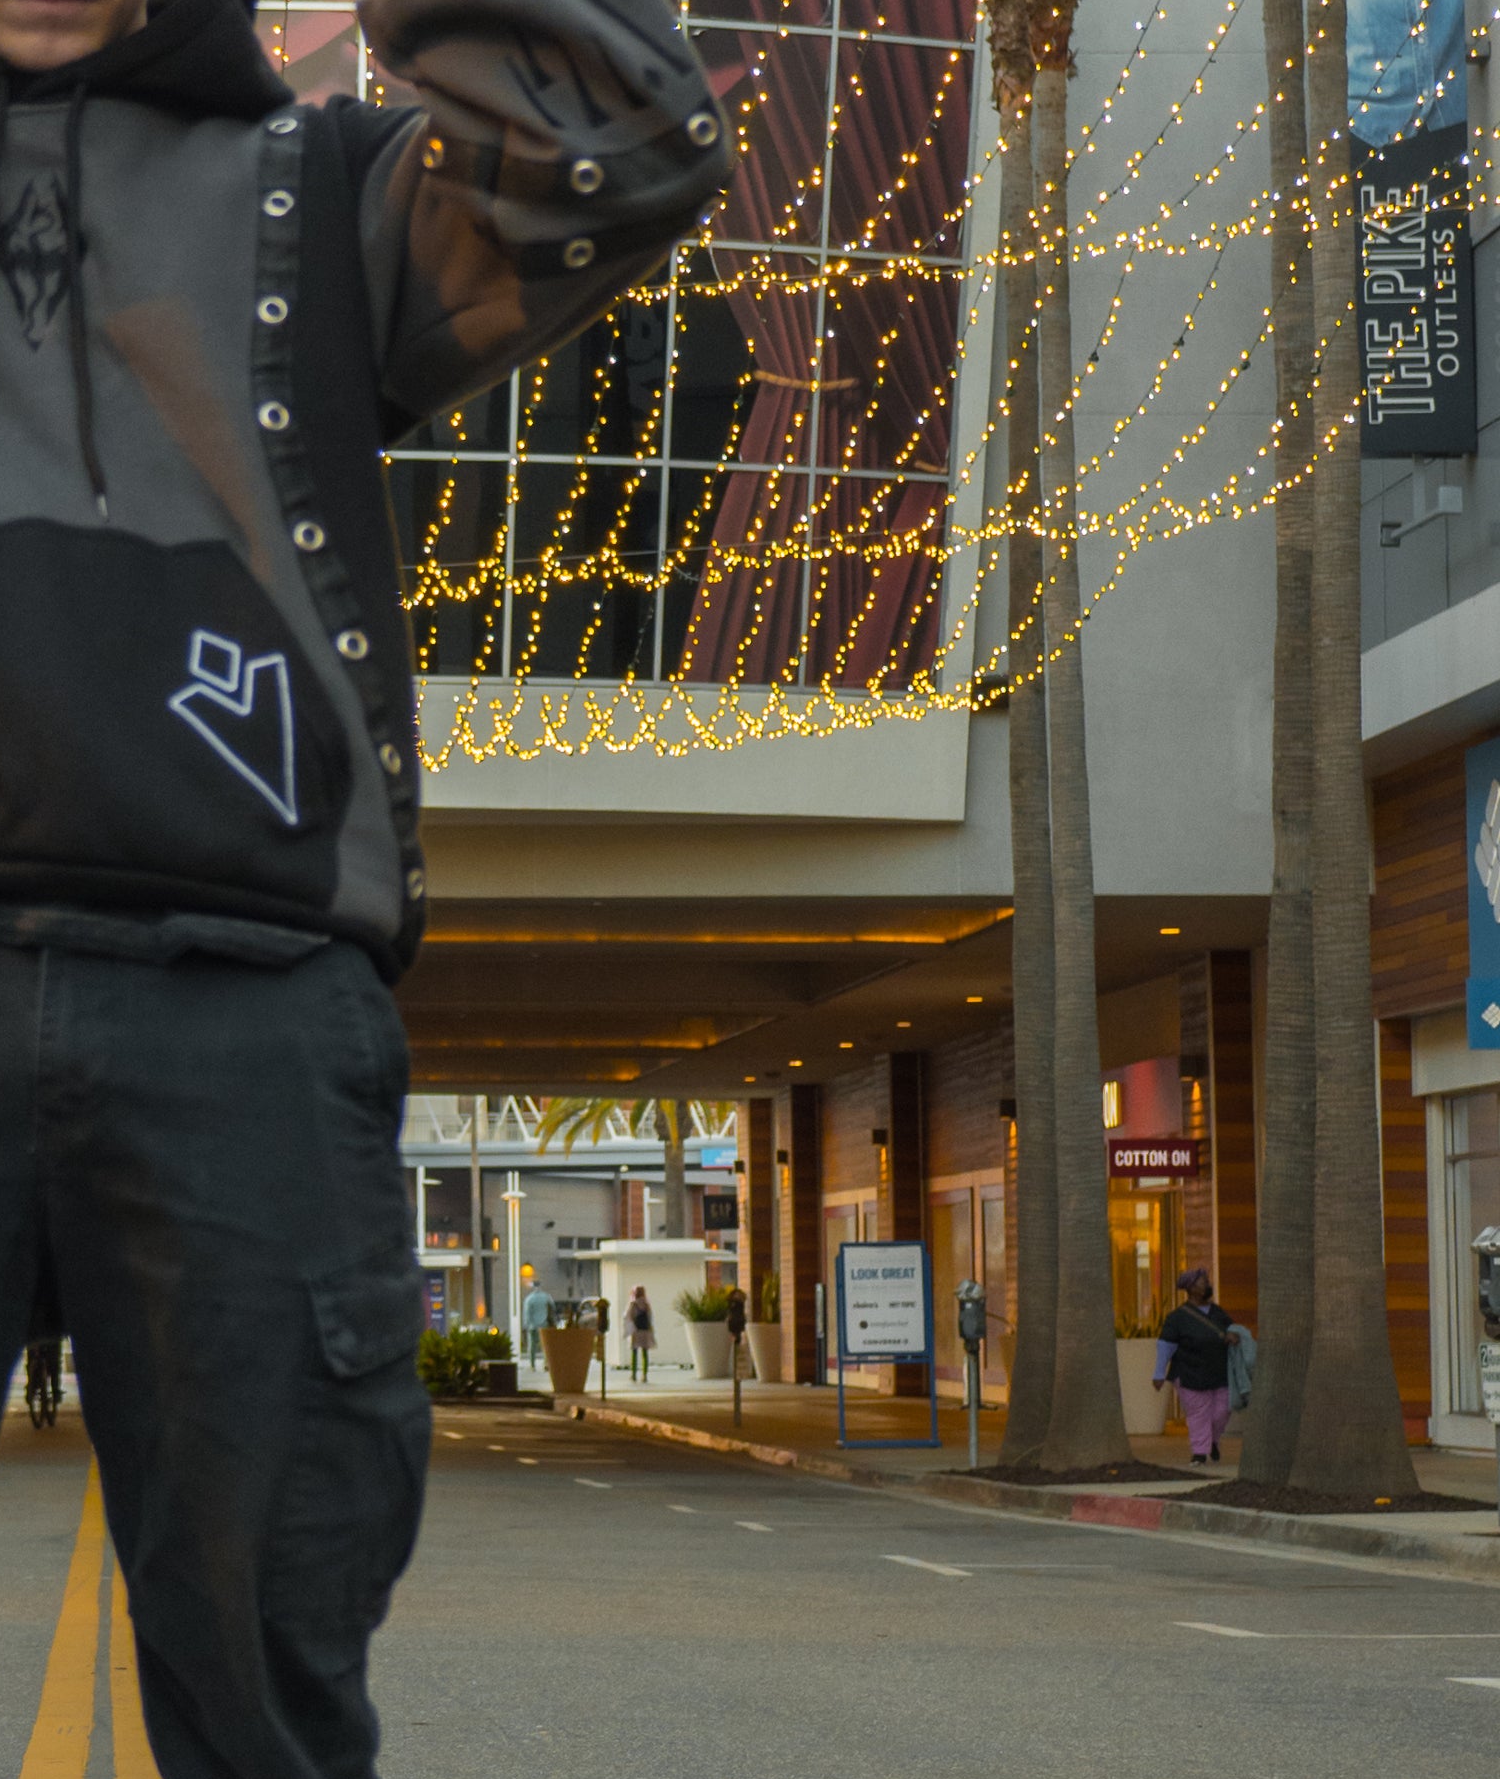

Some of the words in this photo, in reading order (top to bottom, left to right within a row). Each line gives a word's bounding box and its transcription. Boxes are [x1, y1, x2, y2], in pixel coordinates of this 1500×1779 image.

[1361, 184, 1429, 305] PIKE
[1432, 228, 1460, 377] OUTLETS
[1364, 319, 1436, 425] THE
[1114, 1150, 1168, 1167] COTTON
[1171, 1150, 1191, 1167] ON
[851, 1268, 879, 1280] LOOK
[882, 1267, 916, 1279] GREAT
